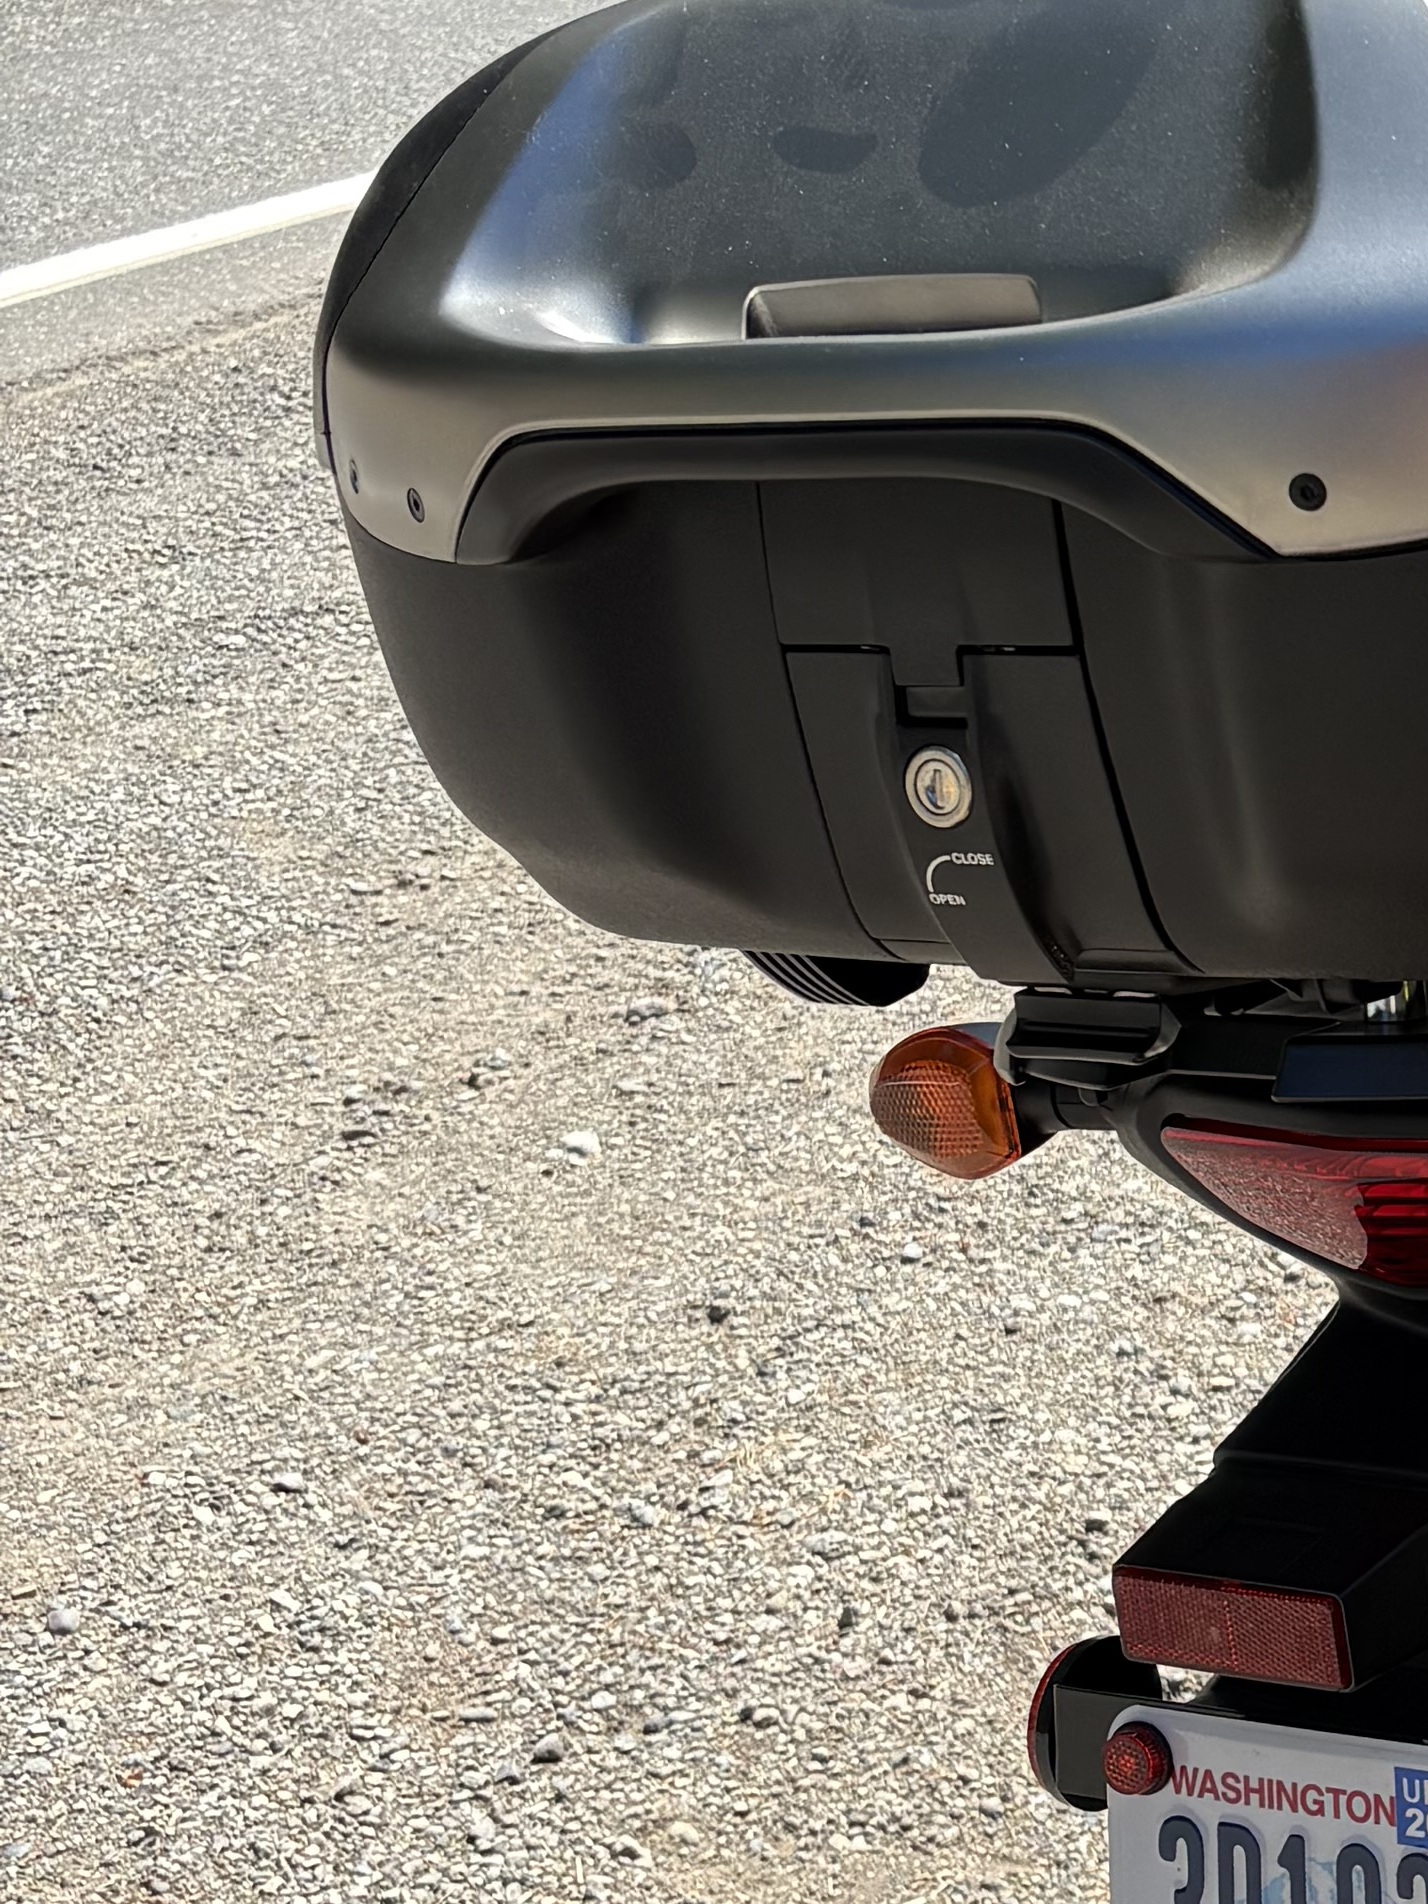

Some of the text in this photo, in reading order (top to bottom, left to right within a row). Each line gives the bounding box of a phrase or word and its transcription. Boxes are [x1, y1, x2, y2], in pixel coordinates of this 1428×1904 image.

[951, 852, 995, 866] CLOSE
[929, 893, 967, 906] OPEN
[1171, 1764, 1398, 1827] WASHINGTON
[1402, 1777, 1421, 1804] U
